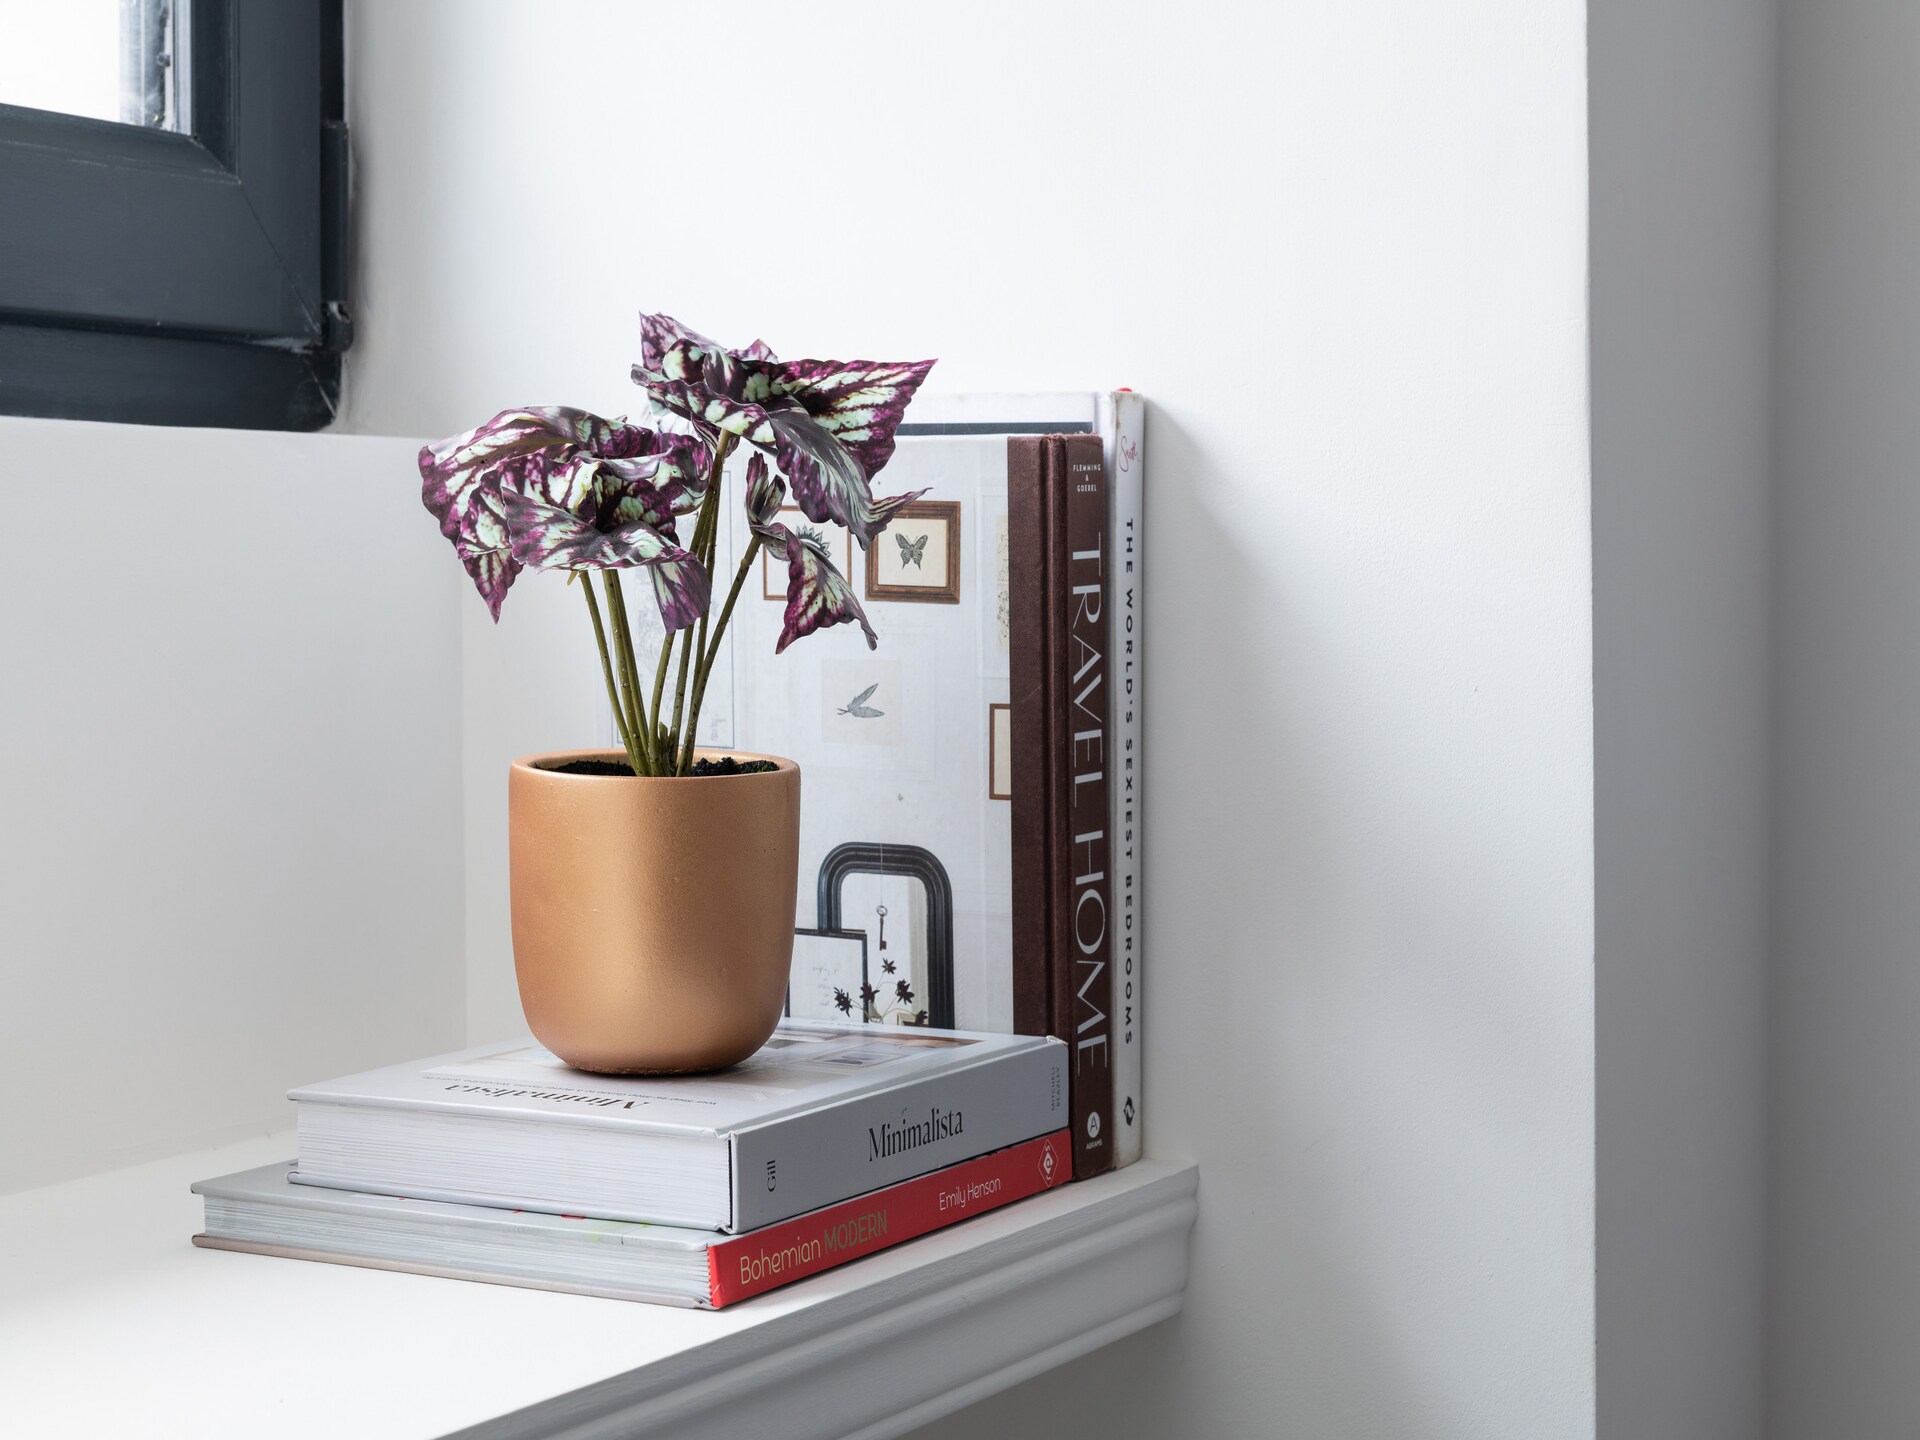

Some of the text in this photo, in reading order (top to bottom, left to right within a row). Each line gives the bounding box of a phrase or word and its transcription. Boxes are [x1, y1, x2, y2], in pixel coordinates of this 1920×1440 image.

[1072, 464, 1101, 472] FLEMMING
[1076, 484, 1097, 492] GOEBEL
[1125, 518, 1133, 1044] THE WORLD'S SEXIEST BEDROOMS
[1072, 531, 1107, 1077] TRAVEL HOME
[444, 1084, 650, 1109] Minimalista
[868, 1107, 964, 1162] Minimalista
[1086, 1139, 1103, 1150] ABRAMS
[766, 1159, 777, 1192] Gill
[939, 1178, 1001, 1211] Emily Henson
[740, 1208, 888, 1285] Bohemian MODERN
